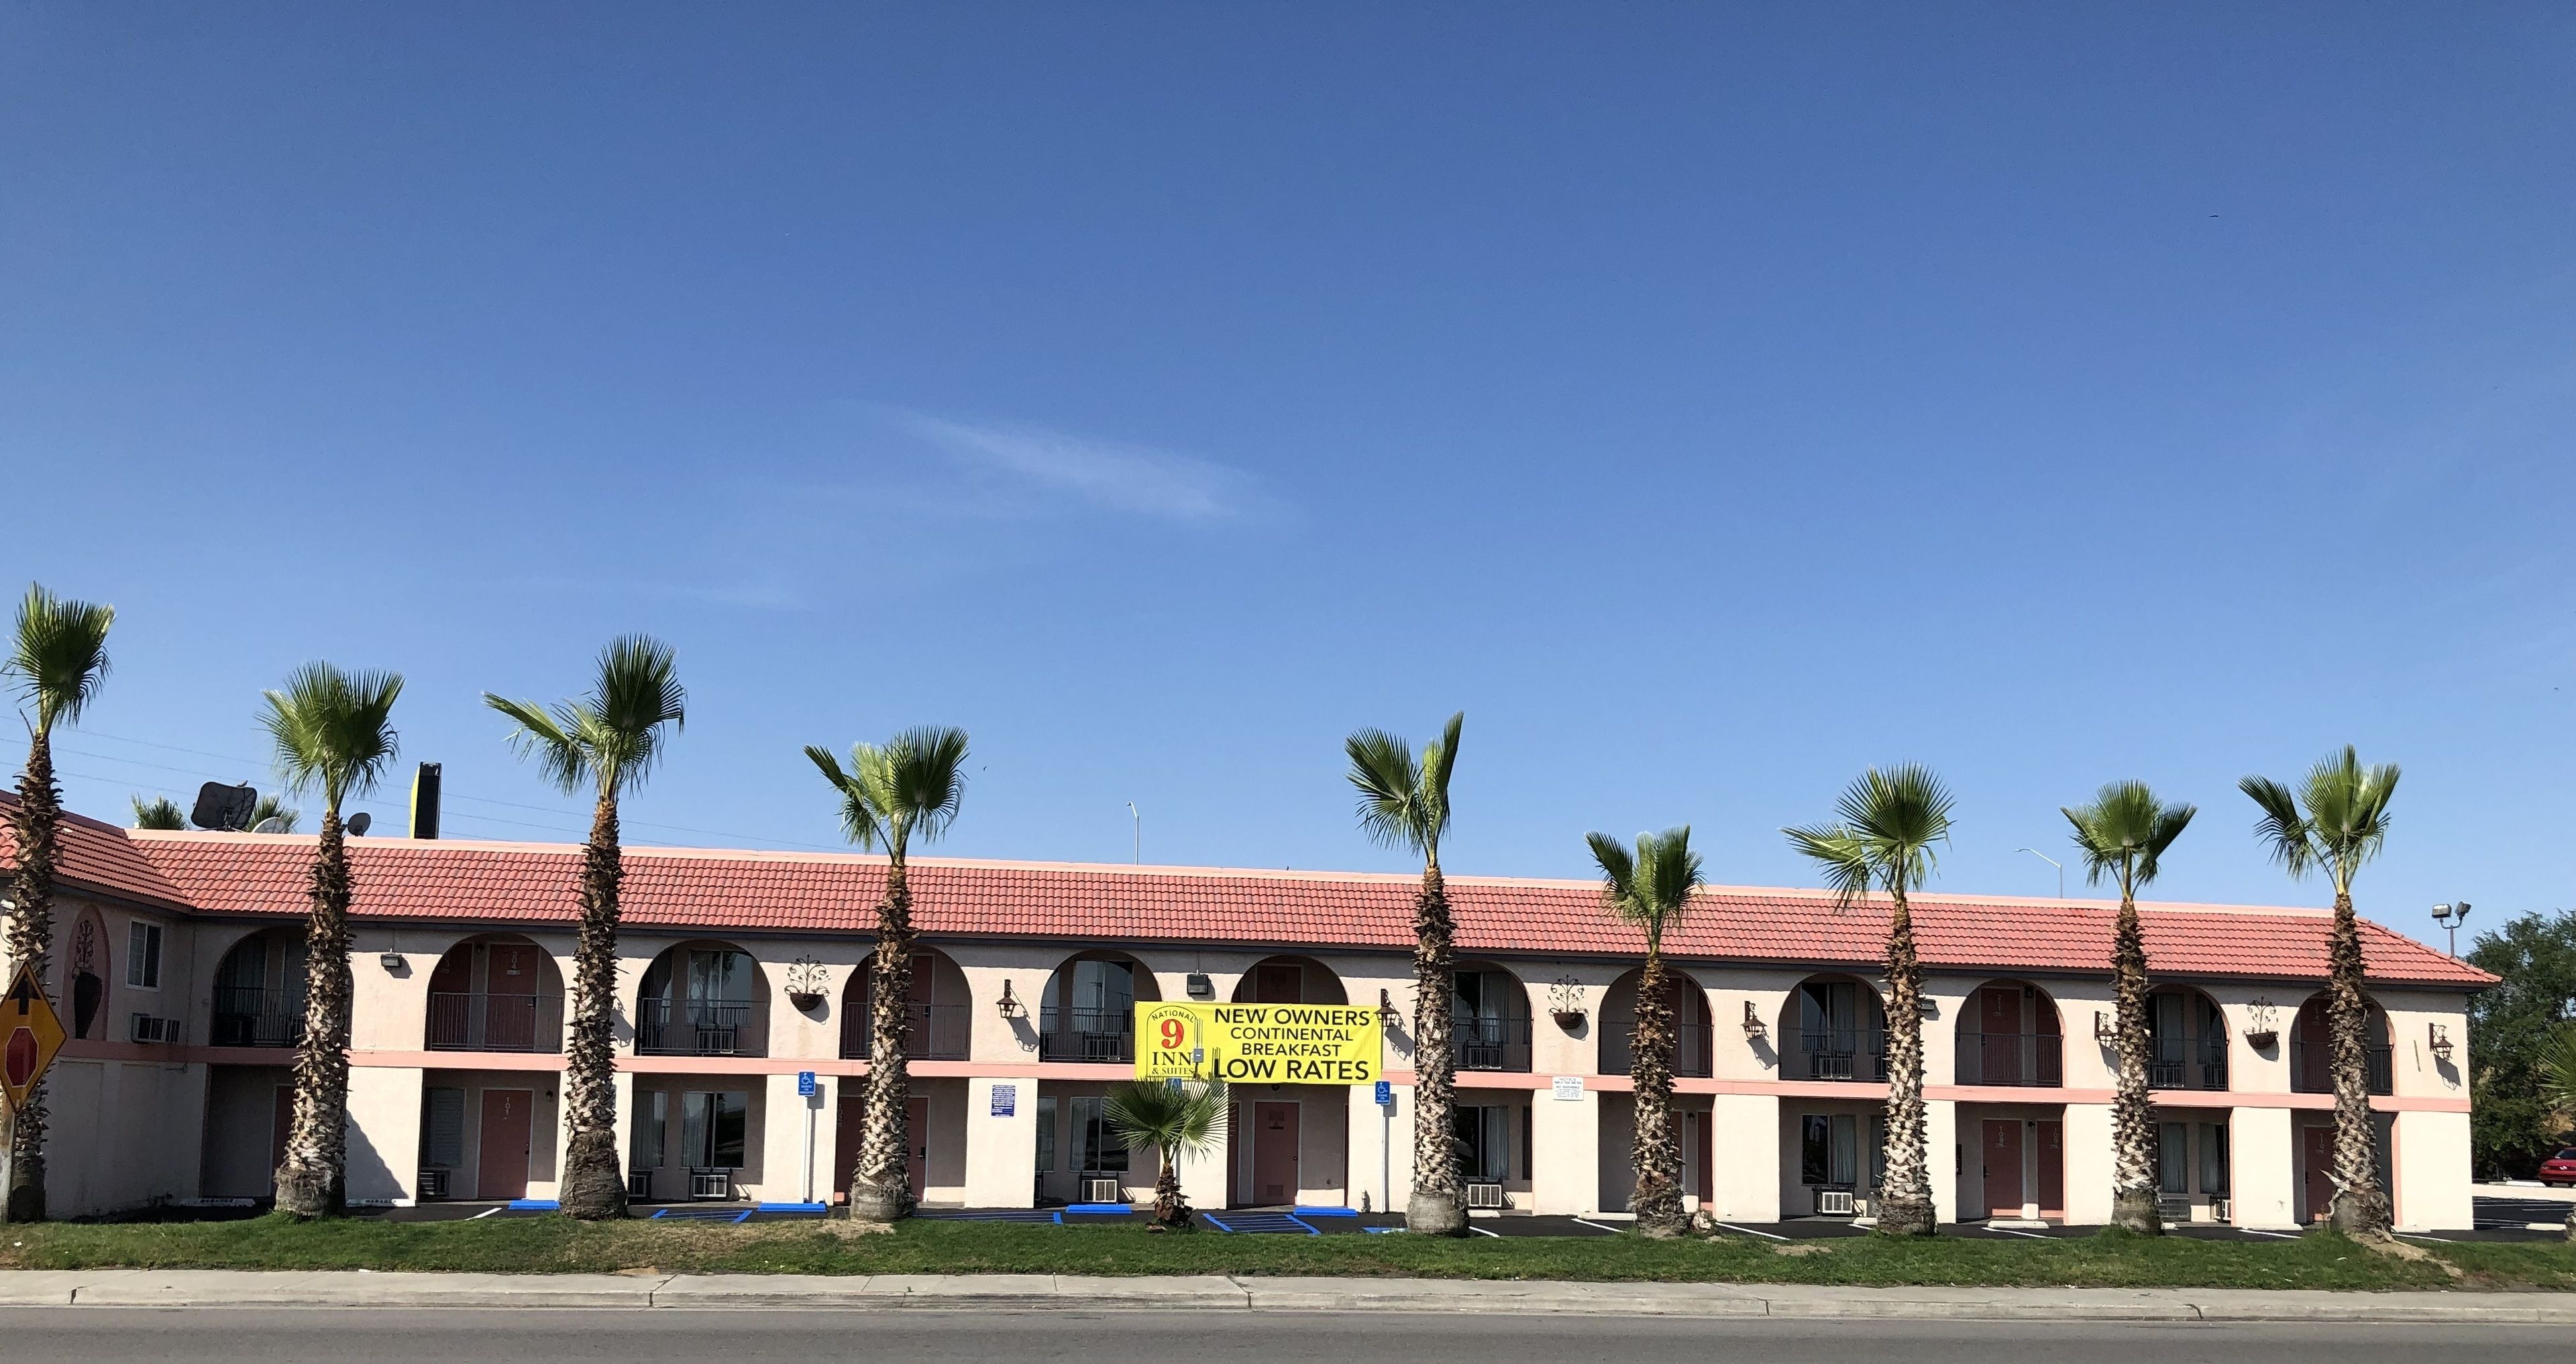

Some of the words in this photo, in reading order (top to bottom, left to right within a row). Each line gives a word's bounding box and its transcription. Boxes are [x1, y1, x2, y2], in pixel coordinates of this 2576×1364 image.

[1151, 1010, 1193, 1023] NATIONAL
[1215, 1009, 1267, 1024] NEW
[1274, 1009, 1370, 1027] OWNERS
[1161, 1019, 1185, 1049] 9
[1230, 1027, 1354, 1041] CONTINENTAL
[1241, 1043, 1342, 1057] BREAKFAST
[1152, 1052, 1193, 1066] INN
[1162, 1067, 1195, 1075] SUITES
[1214, 1058, 1277, 1079] LOW
[1287, 1060, 1369, 1081] RATES
